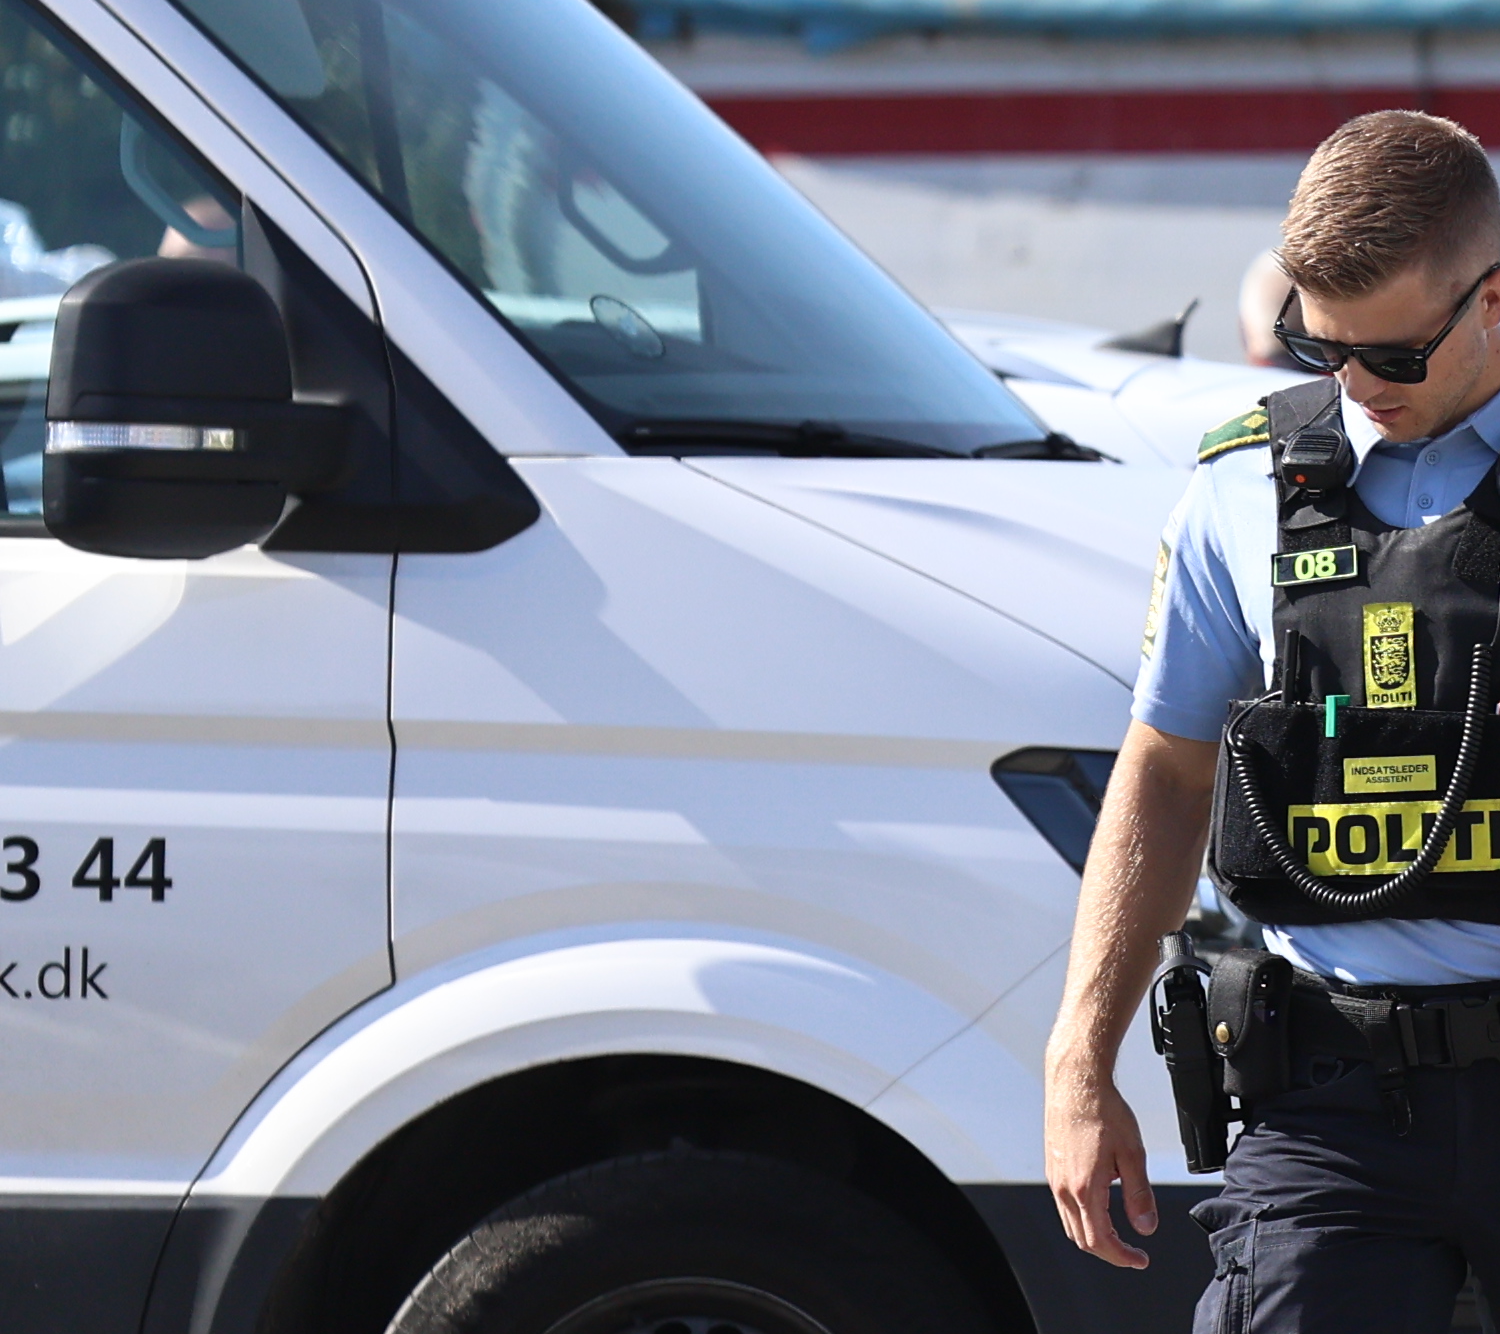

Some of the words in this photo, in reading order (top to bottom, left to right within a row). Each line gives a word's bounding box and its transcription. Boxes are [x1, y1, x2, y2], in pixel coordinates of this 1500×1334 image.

[1295, 551, 1337, 579] 08
[1372, 691, 1413, 704] POLITI
[1351, 764, 1429, 776] INDSATSLEDER
[1365, 775, 1413, 784] ASSISTENT
[0, 835, 41, 902] 3
[71, 836, 173, 903] 44
